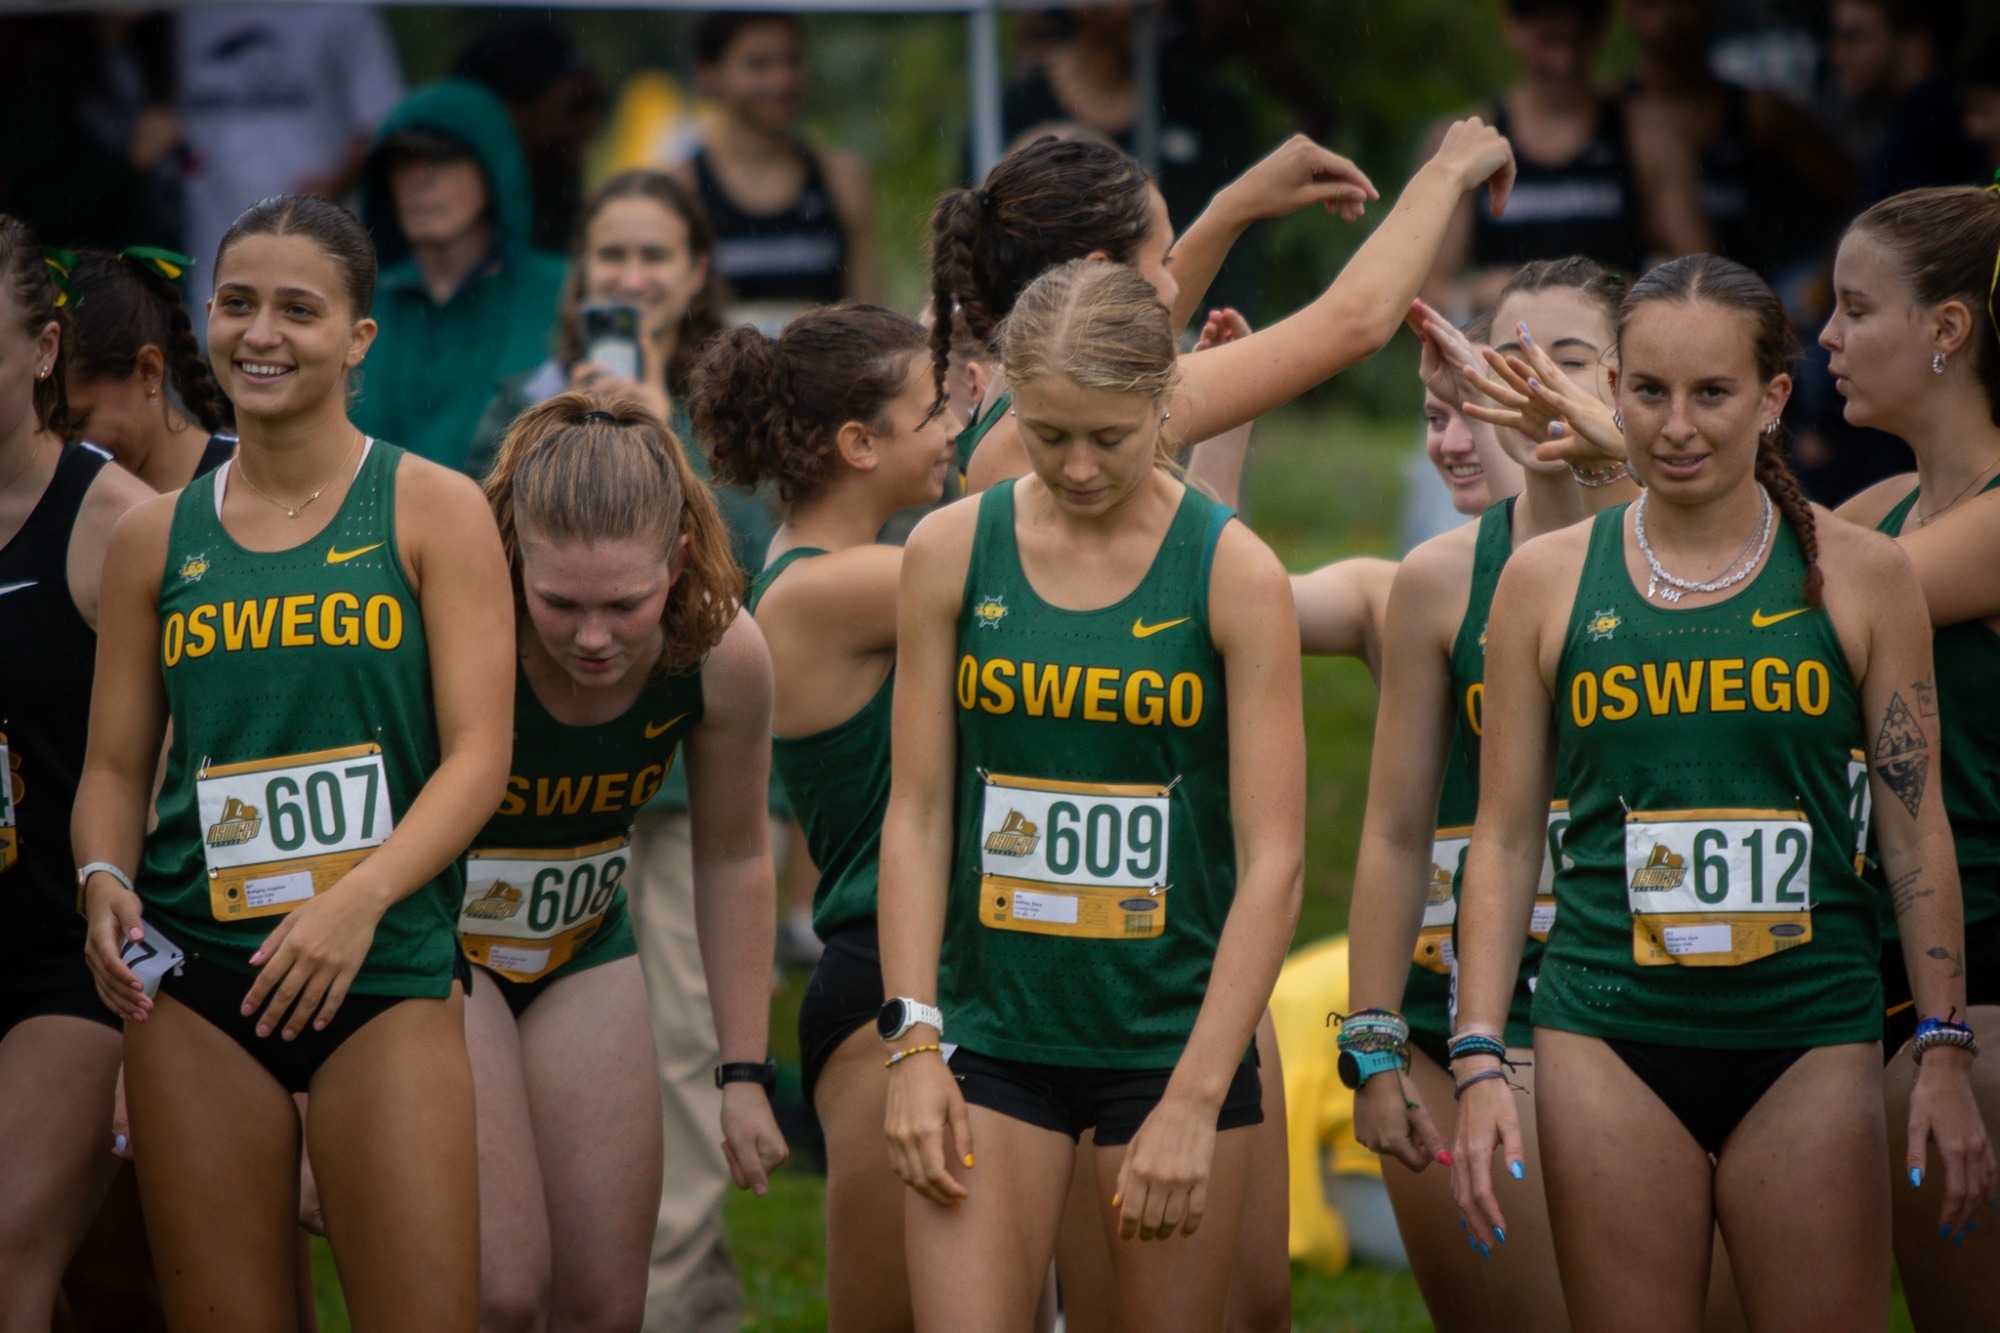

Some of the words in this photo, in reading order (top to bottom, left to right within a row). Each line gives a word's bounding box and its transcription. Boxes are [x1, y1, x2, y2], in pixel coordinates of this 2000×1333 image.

[164, 591, 404, 669] OSWEGO
[957, 653, 1204, 729] OSWEGO
[1570, 656, 1831, 729] OSWEGO
[265, 763, 380, 852] 607
[493, 748, 680, 818] SWEG
[1045, 800, 1163, 880] 609
[1692, 827, 1809, 905] 612
[527, 856, 627, 933] 608
